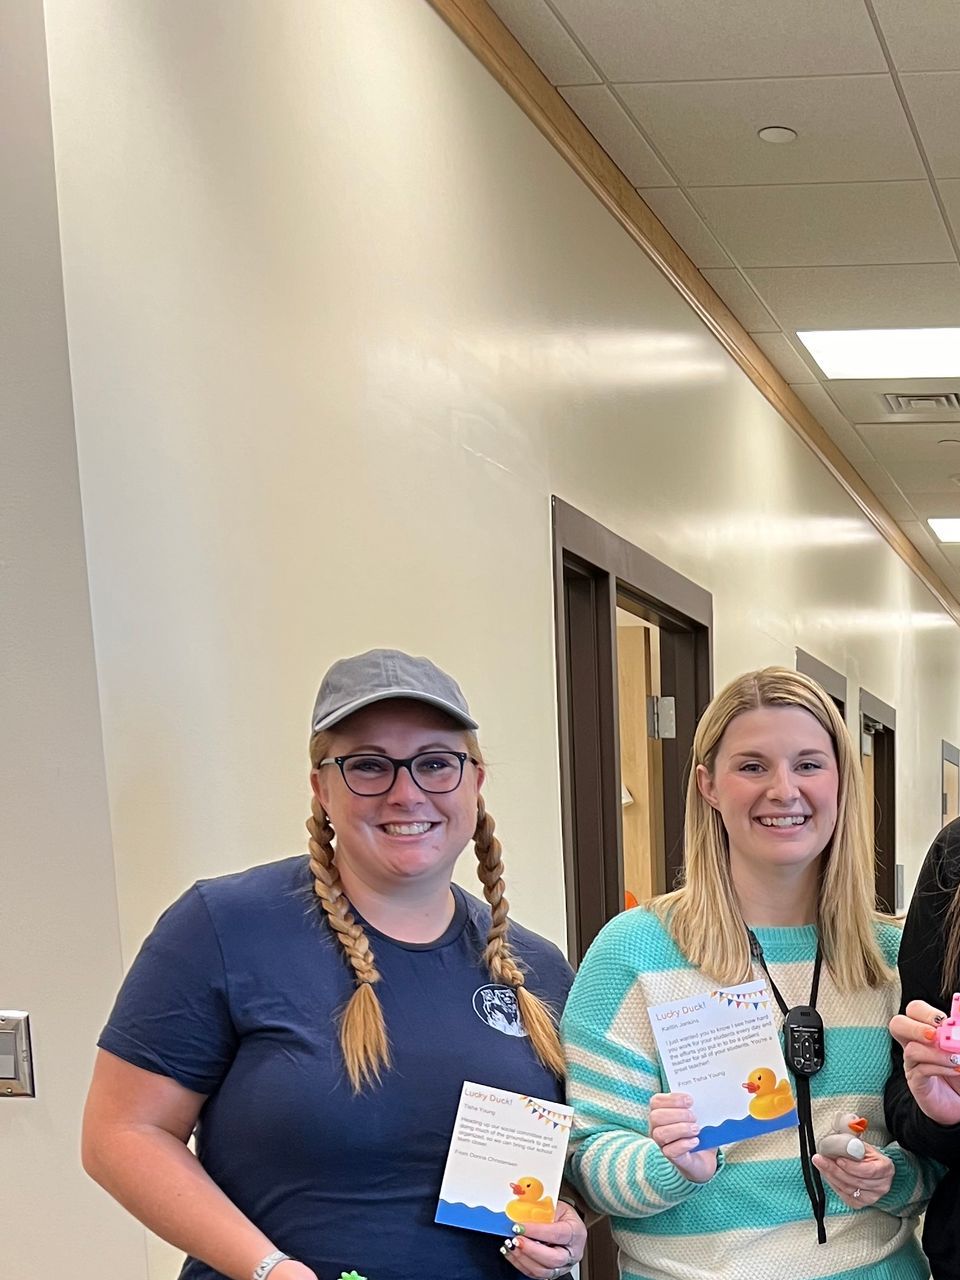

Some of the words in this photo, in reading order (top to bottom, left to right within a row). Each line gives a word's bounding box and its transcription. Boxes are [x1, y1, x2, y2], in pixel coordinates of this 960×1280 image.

[655, 1010, 680, 1021] Lucky
[681, 1001, 706, 1014] Duck!
[464, 1088, 488, 1101] Lucky
[489, 1094, 513, 1105] Duck!
